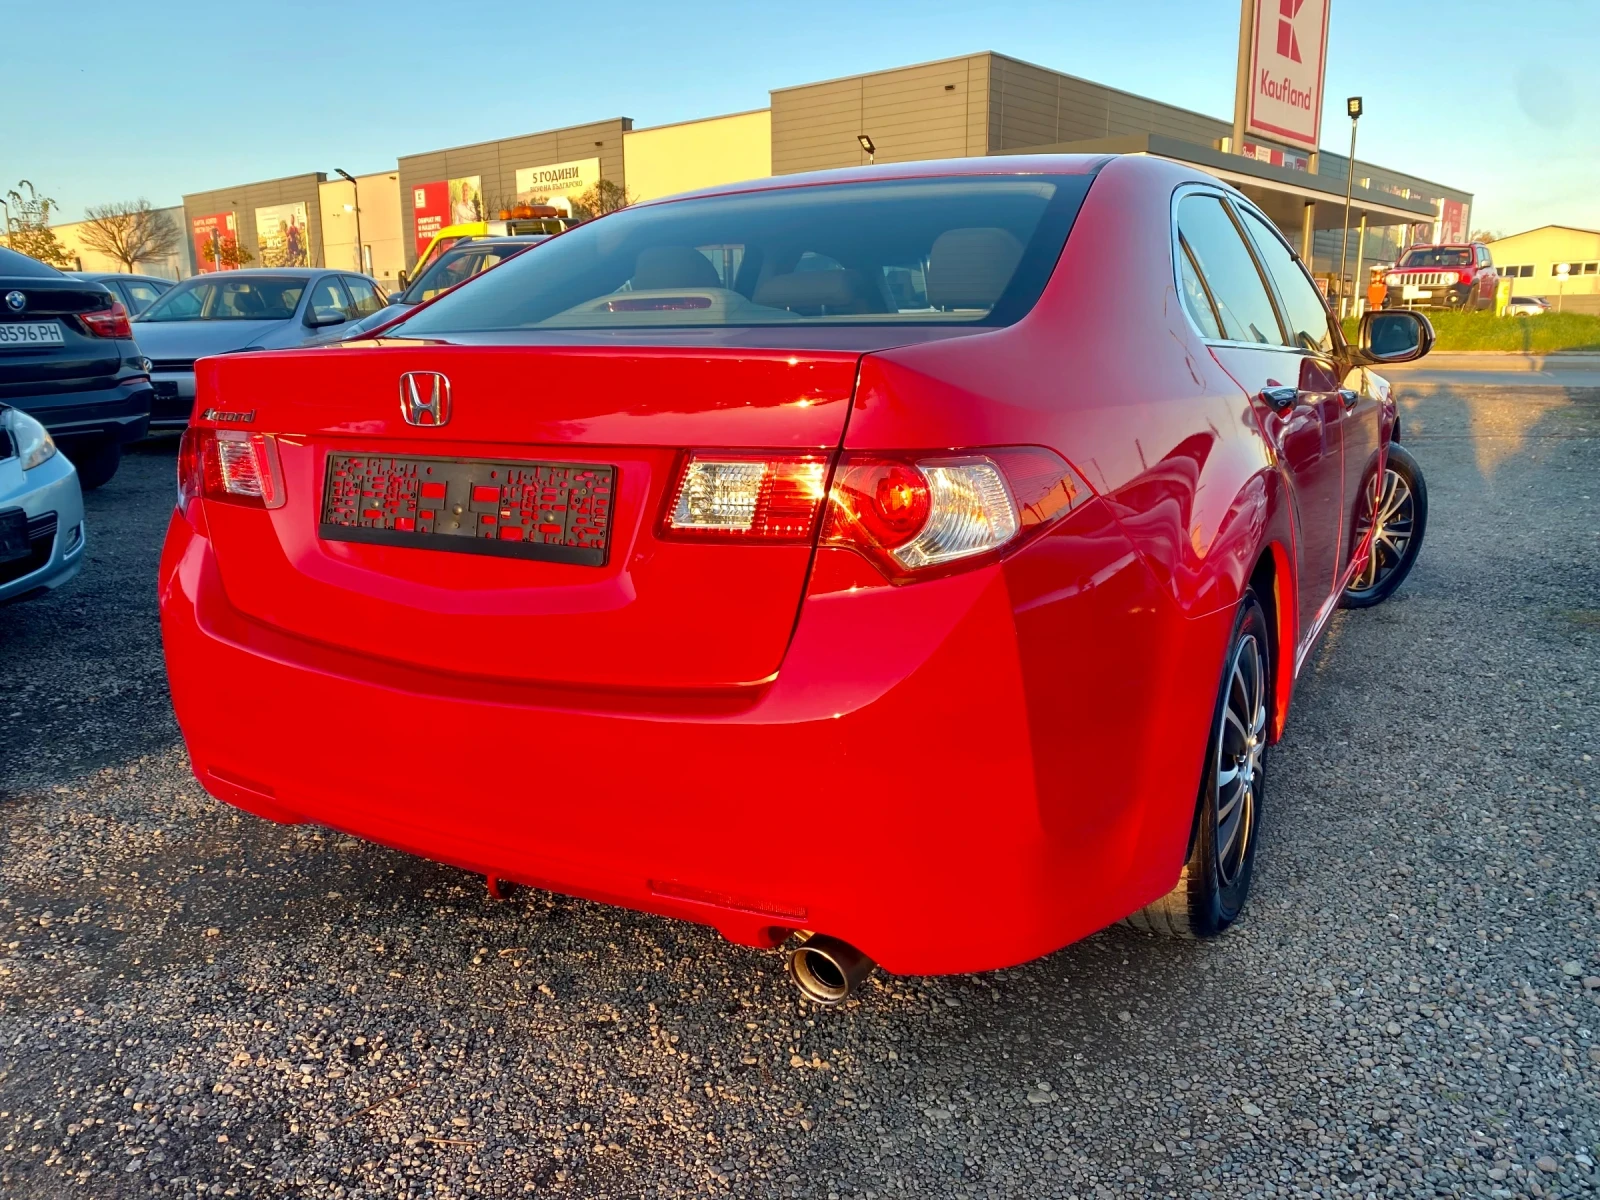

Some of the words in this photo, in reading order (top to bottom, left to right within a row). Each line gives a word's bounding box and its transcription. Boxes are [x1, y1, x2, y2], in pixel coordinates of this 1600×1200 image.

[1260, 68, 1312, 111] Kaufland
[532, 172, 538, 184] 5
[540, 166, 579, 183] ГОДИНИ
[0, 325, 37, 341] 8596
[37, 325, 61, 341] PH
[200, 407, 256, 423] Accord
